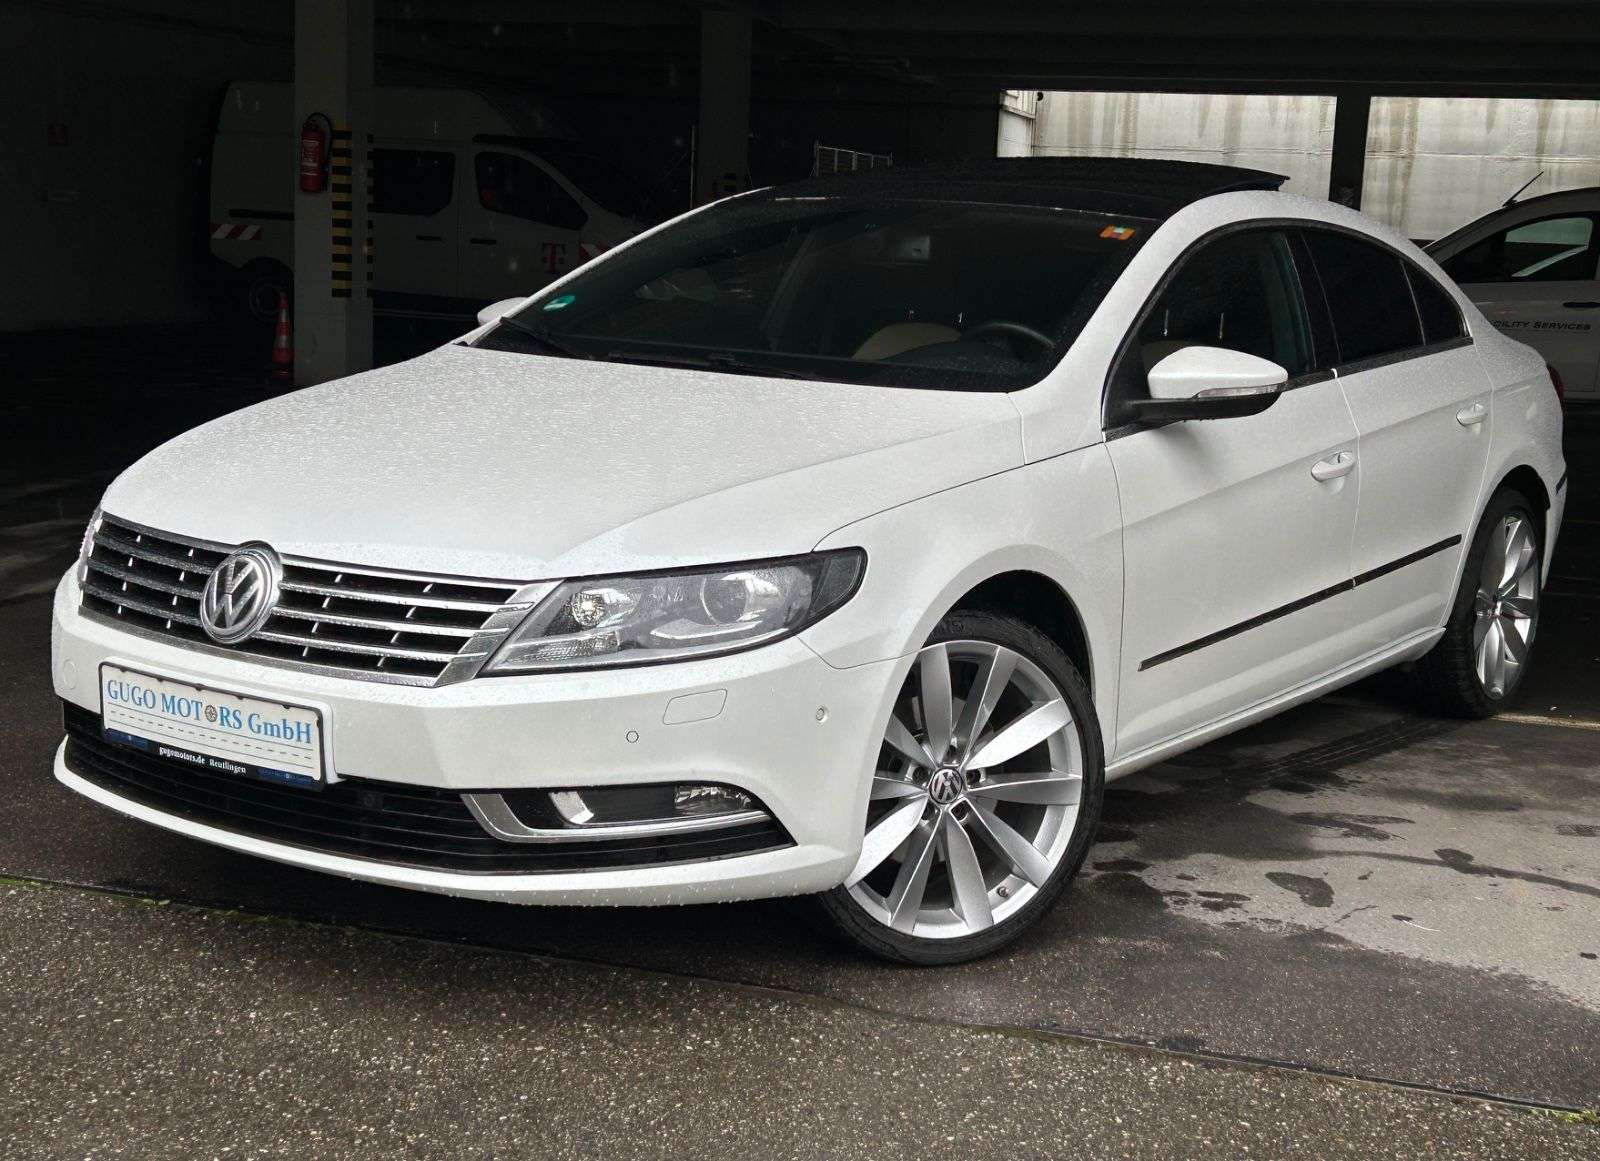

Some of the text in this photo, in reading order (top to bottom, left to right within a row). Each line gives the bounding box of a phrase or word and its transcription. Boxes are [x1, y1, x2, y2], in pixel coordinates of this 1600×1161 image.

[1491, 320, 1592, 331] CILITY SERVICES
[107, 679, 156, 709] GUGO
[248, 713, 312, 744] GmbH
[159, 746, 246, 774] gugomotors.de Reutlingen
